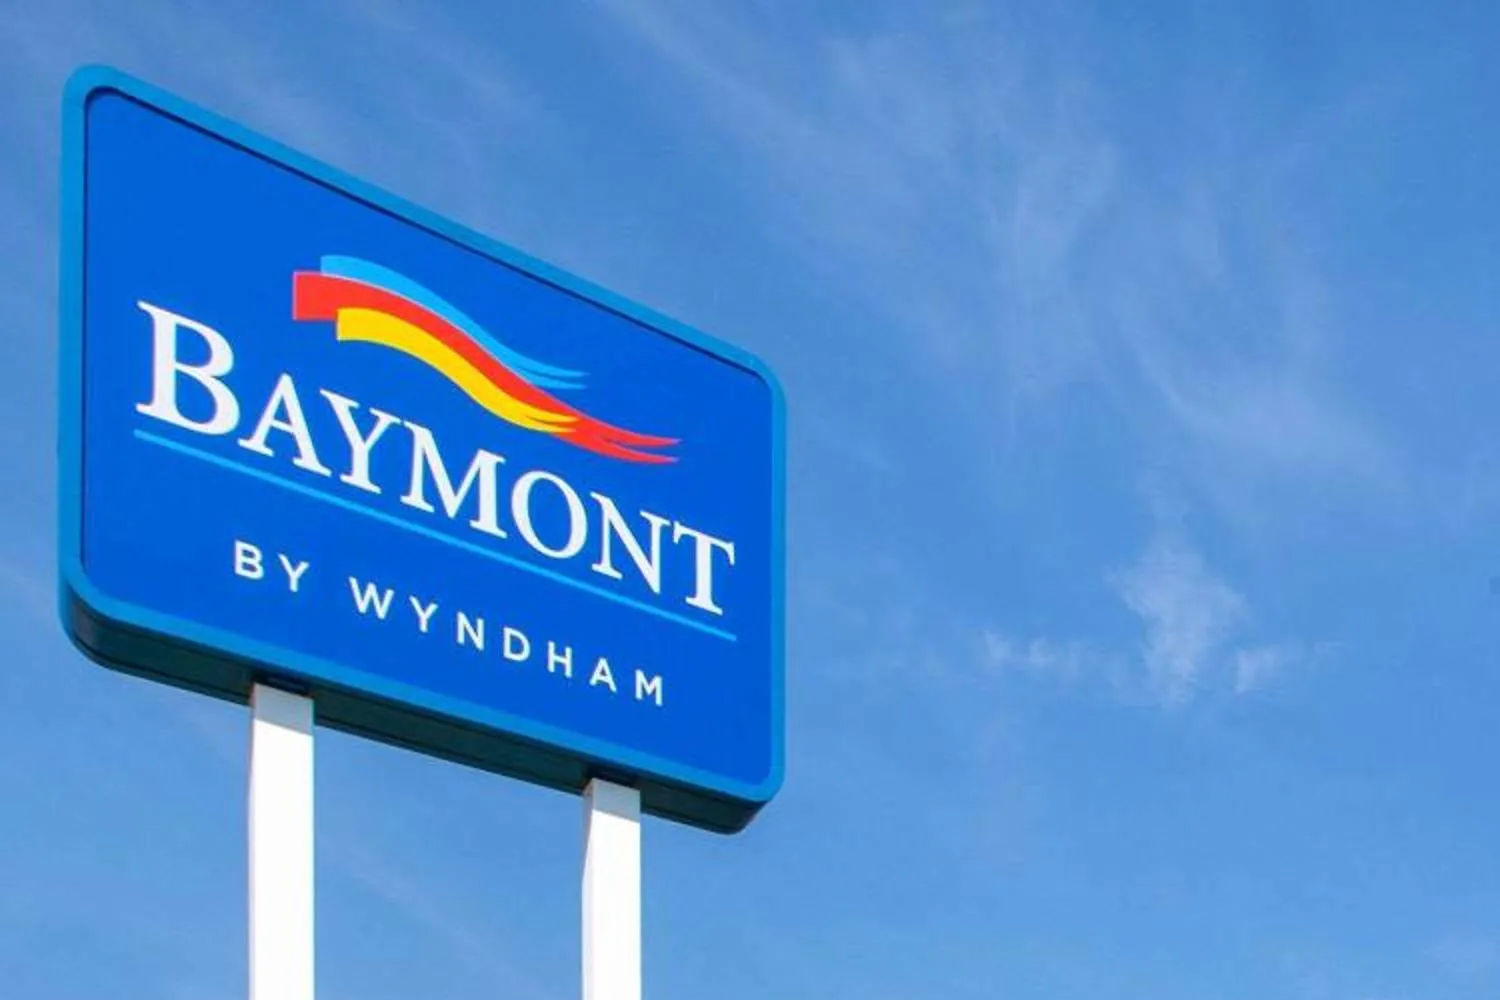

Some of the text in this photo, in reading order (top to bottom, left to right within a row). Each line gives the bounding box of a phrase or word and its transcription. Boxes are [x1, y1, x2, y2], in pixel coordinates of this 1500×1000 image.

[135, 301, 736, 616] BAYMONT
[234, 540, 665, 706] BY WYNDHAM
